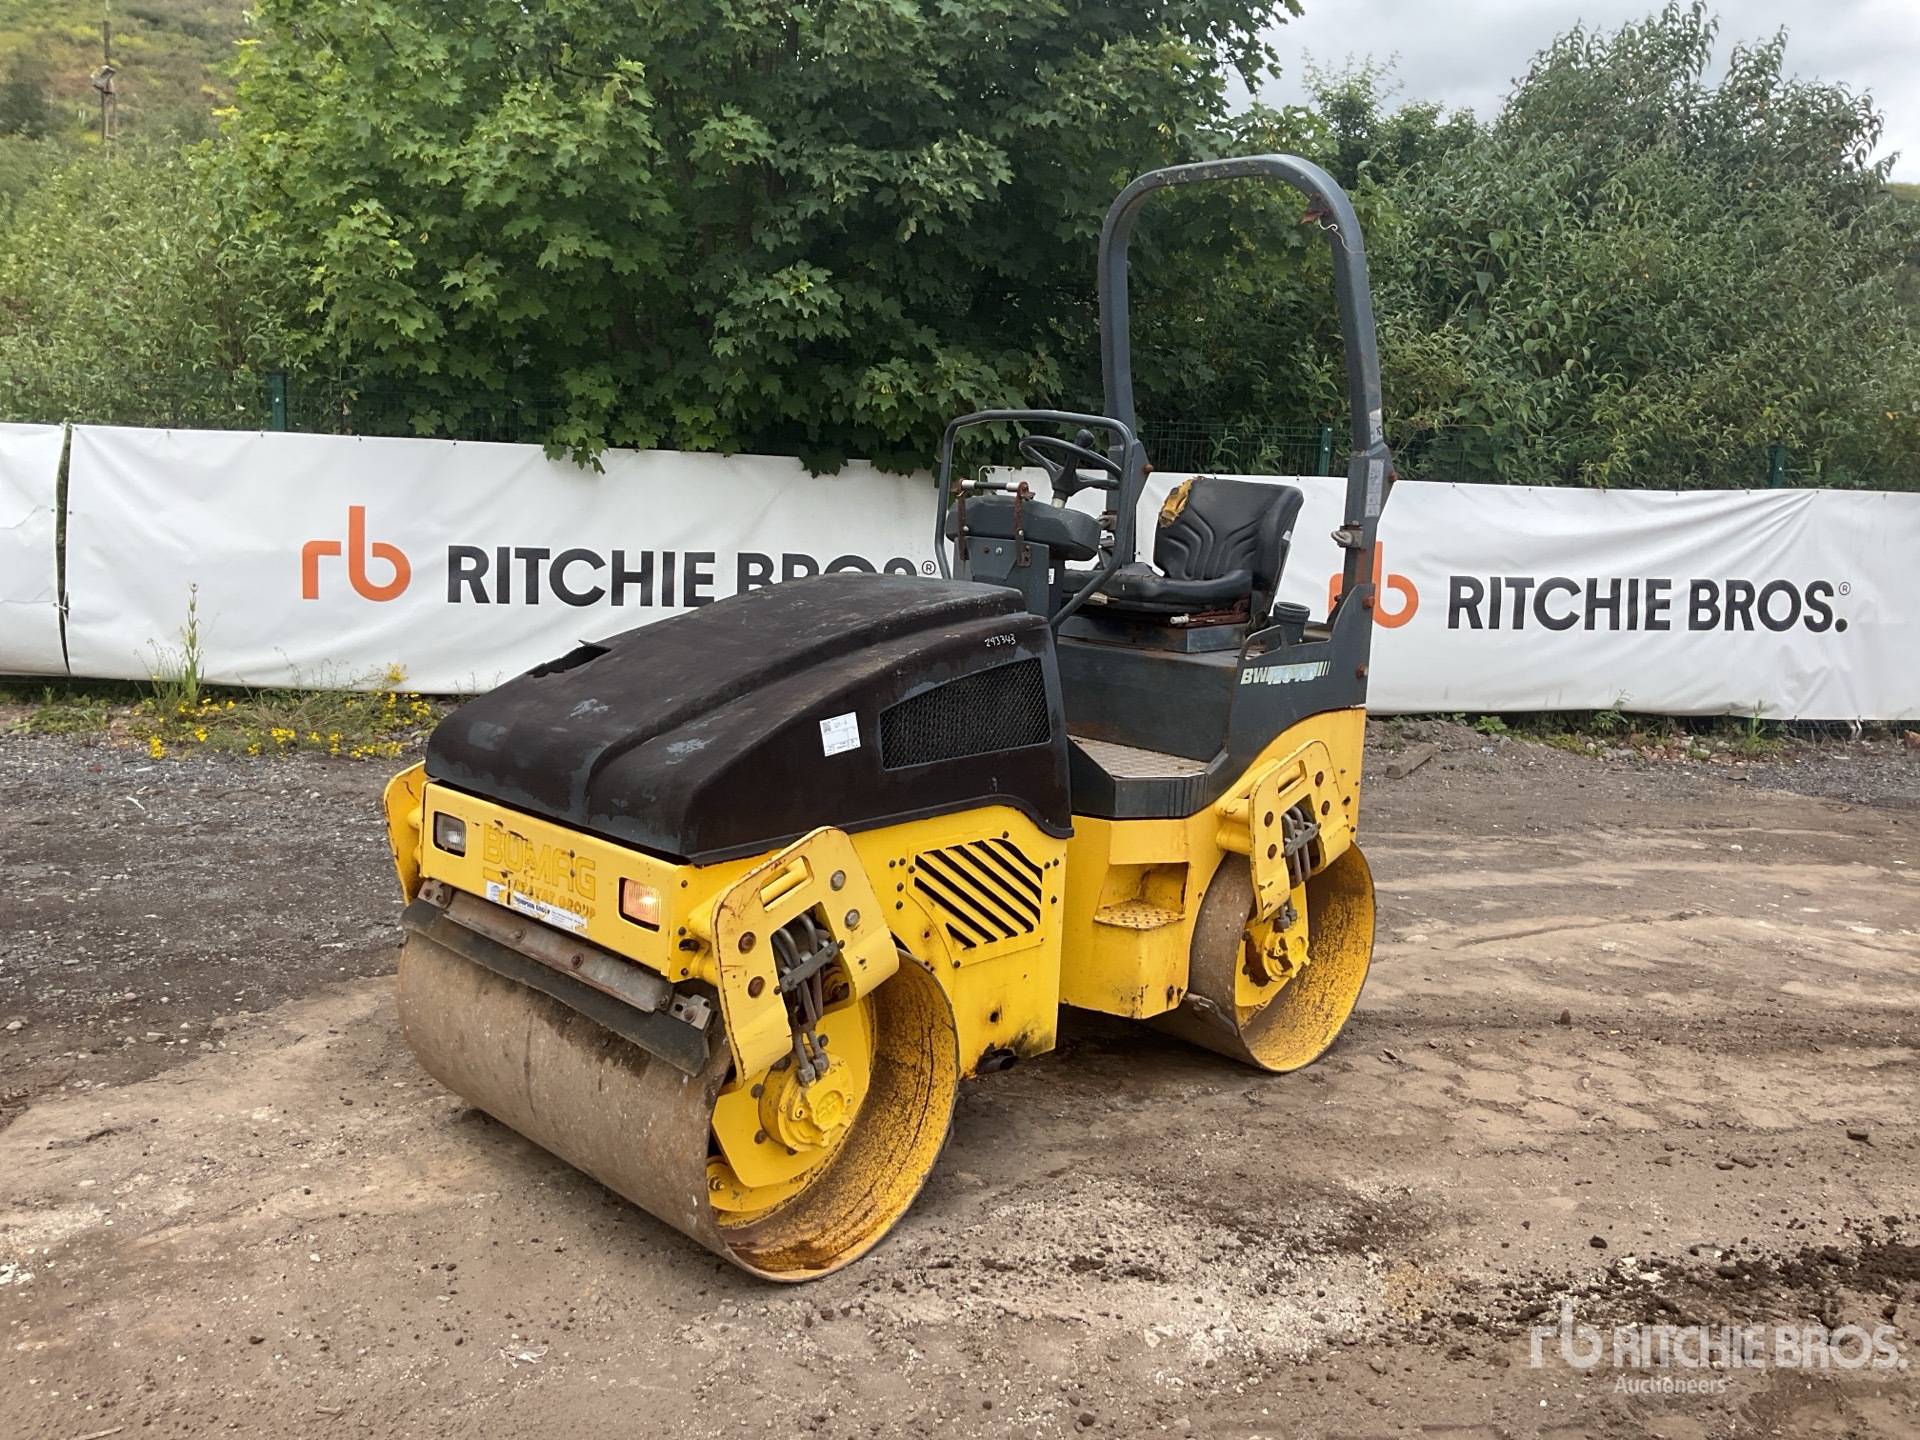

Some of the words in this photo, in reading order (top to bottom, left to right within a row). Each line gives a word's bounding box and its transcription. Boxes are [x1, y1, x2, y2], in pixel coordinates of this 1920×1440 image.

[302, 505, 412, 602] rb
[447, 545, 716, 607] RITCHIE
[1448, 575, 1672, 631] RITCHIE
[984, 633, 1017, 647] 293343
[483, 823, 596, 901] BOMAG
[557, 894, 597, 920] GROUP
